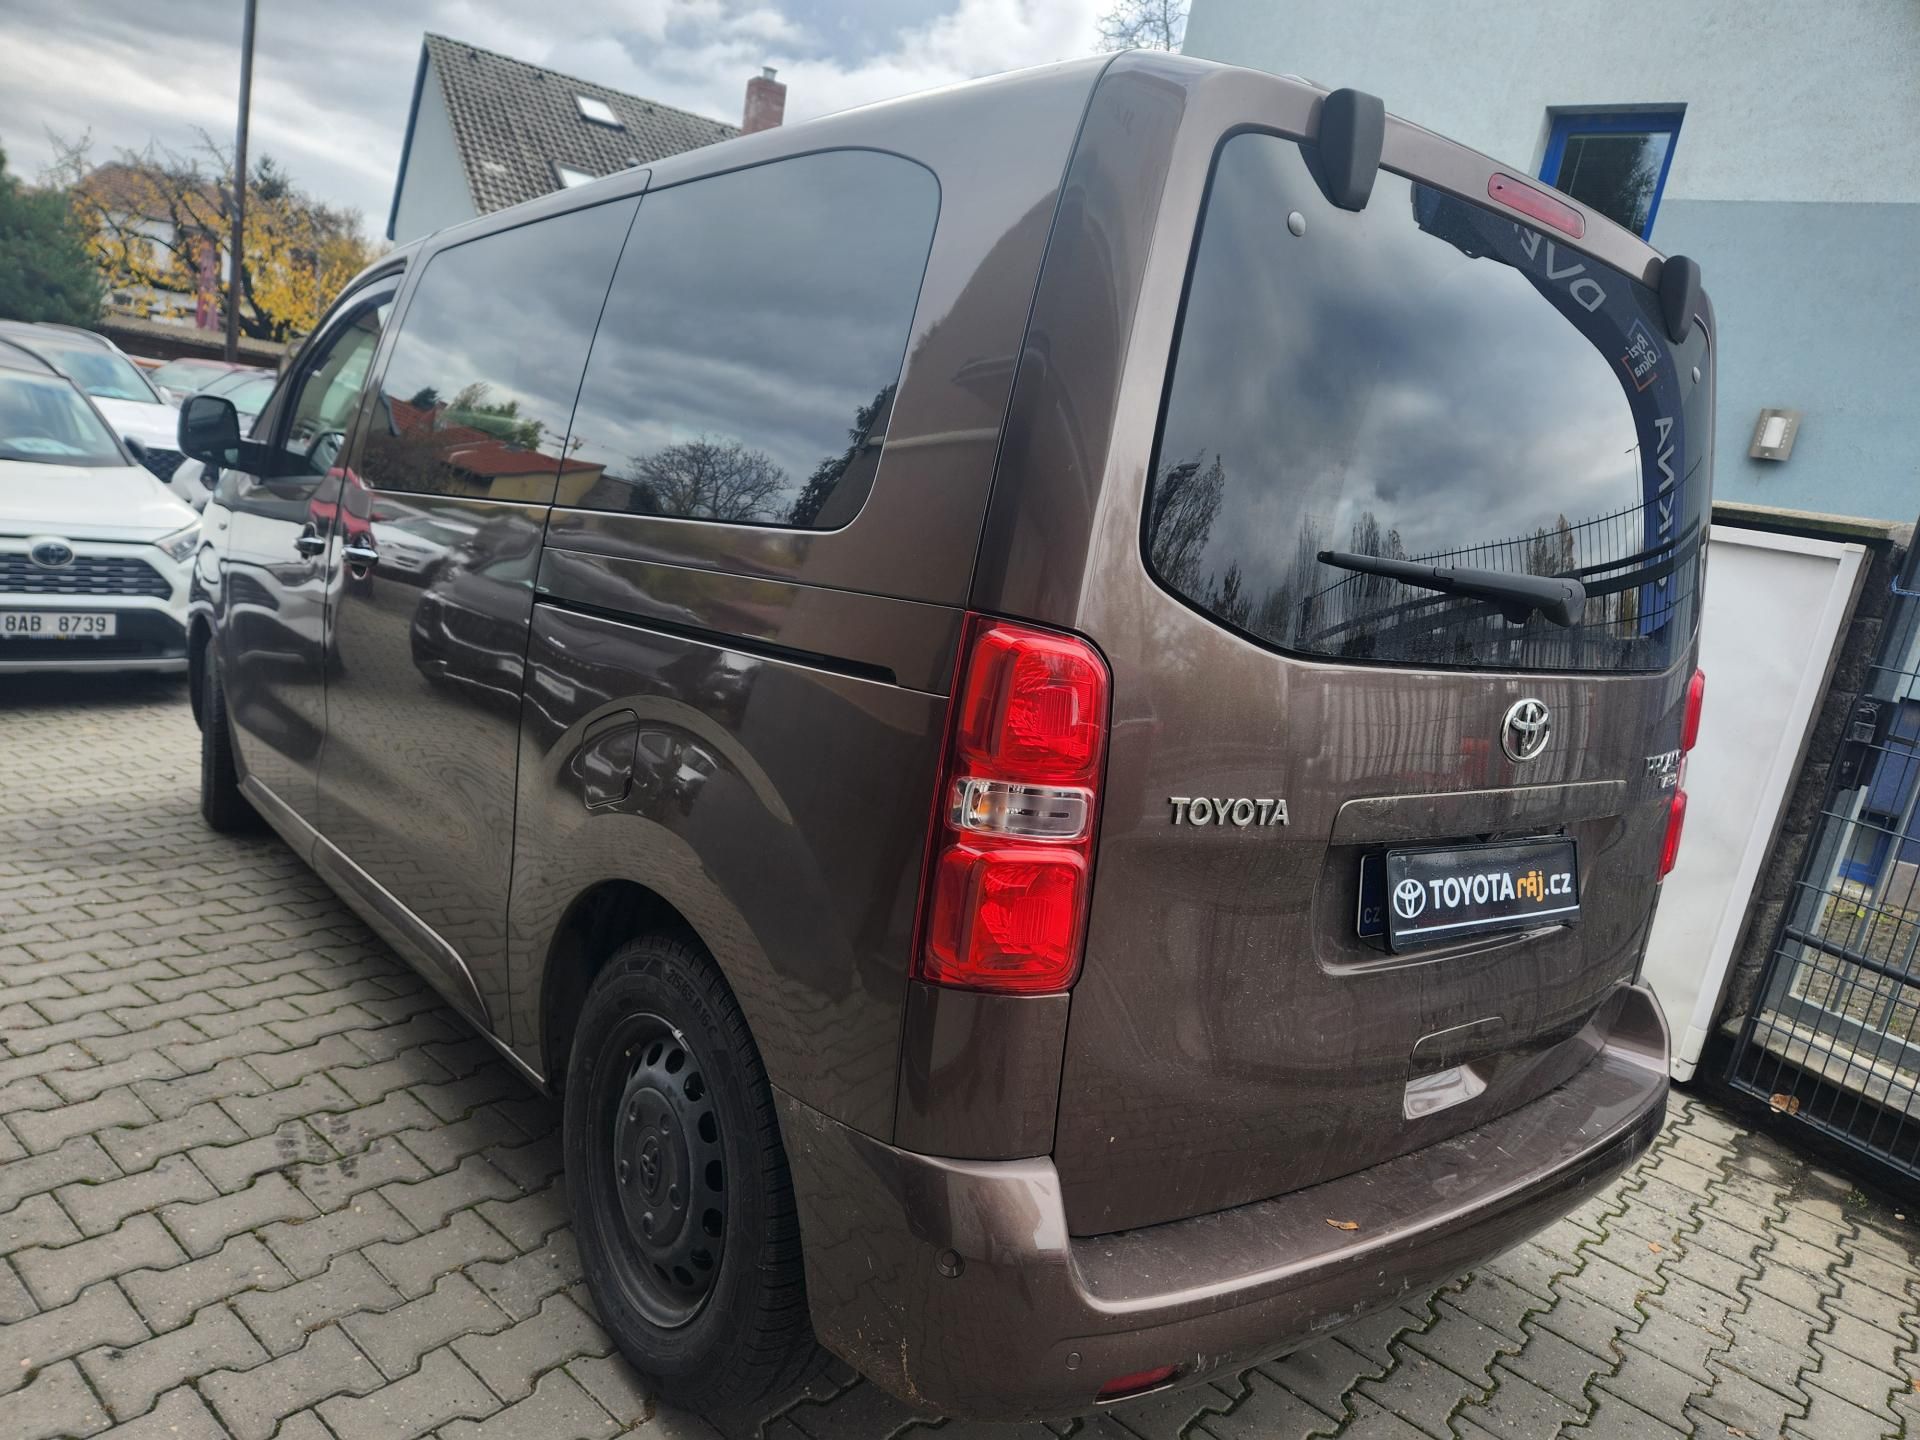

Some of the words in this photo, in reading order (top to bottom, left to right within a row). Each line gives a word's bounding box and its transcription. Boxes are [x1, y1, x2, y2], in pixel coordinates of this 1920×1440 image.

[5, 615, 42, 632] 8AB
[58, 616, 106, 632] 8739
[1168, 796, 1290, 826] TOYOTA
[1364, 906, 1381, 925] CZ
